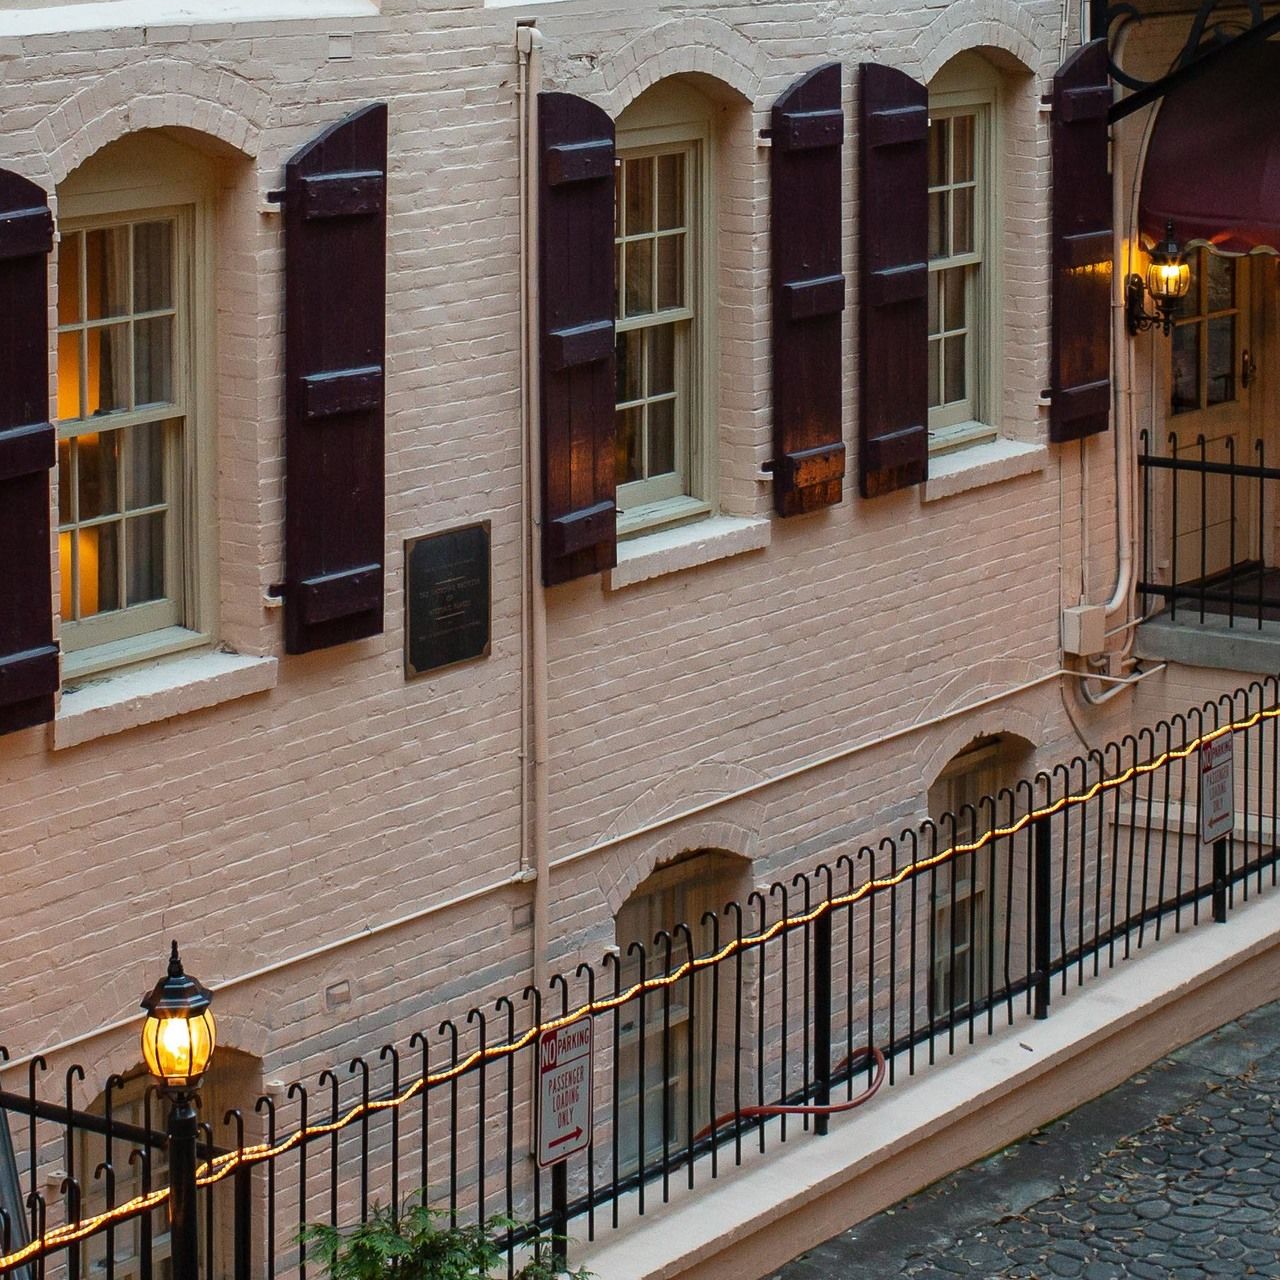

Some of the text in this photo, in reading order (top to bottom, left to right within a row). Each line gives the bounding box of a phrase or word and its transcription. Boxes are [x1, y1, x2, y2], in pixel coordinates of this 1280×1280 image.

[541, 1027, 590, 1068] NO PARKING
[548, 1065, 584, 1096] PASSENGER
[553, 1085, 580, 1113] LOADING
[558, 1107, 574, 1129] ONLY
